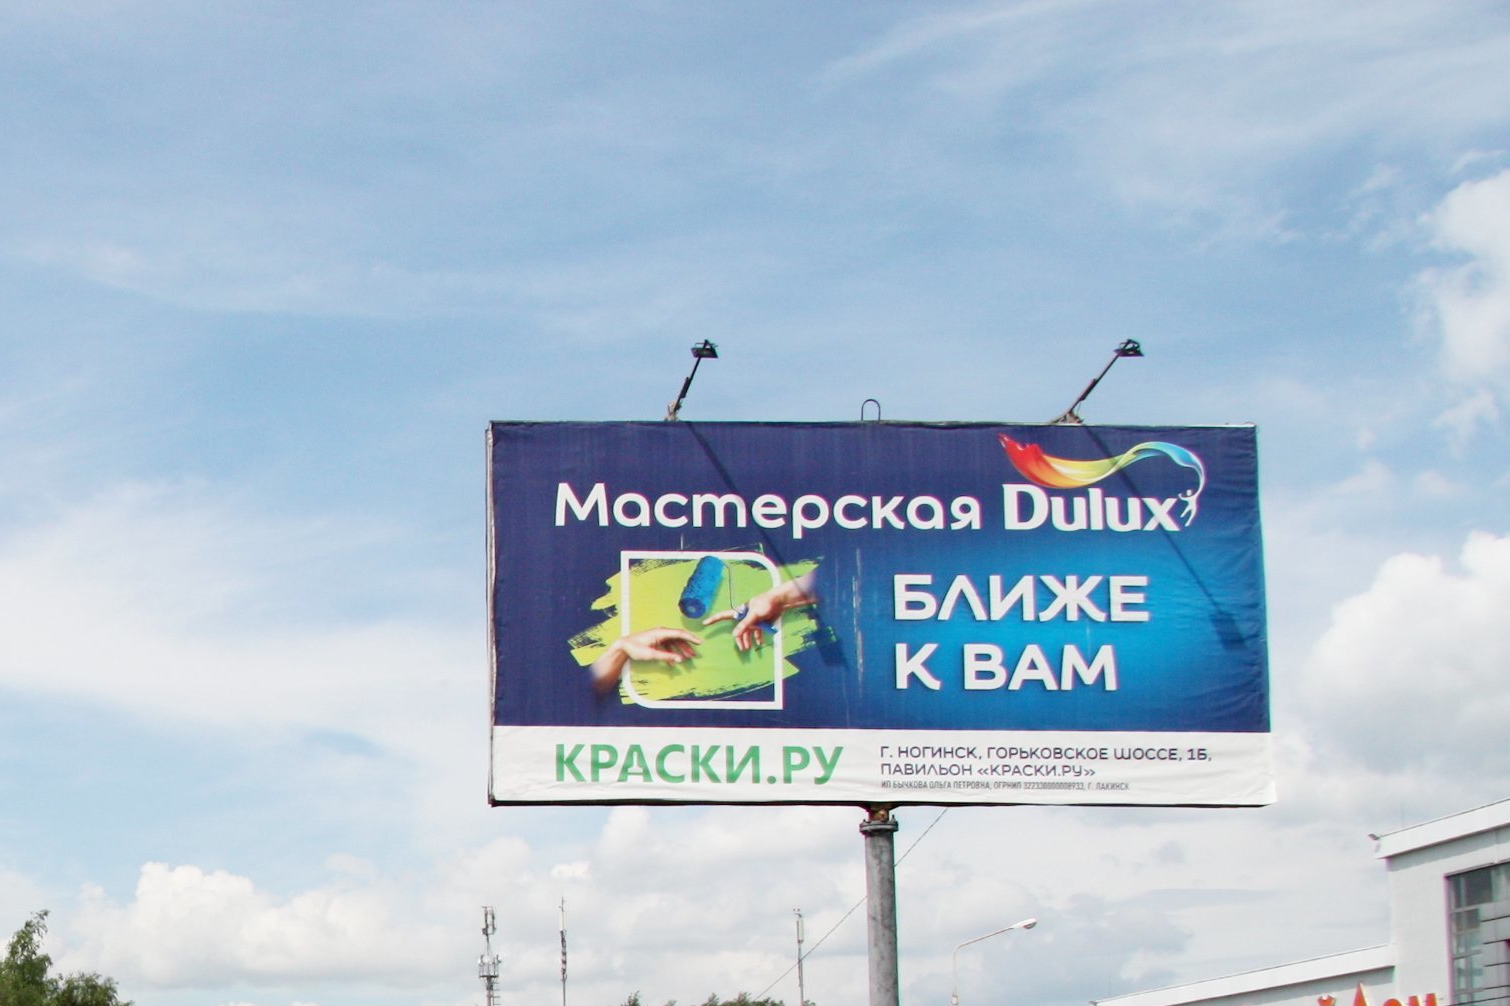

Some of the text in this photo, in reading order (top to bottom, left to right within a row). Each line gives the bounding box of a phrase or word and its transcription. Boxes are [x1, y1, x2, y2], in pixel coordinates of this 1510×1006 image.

[555, 482, 1180, 539] Мастерская Dulux
[893, 574, 1149, 623] БЛИЖЕ
[895, 644, 1118, 691] К ВАМ
[555, 743, 844, 785] КРАСКИ.РУ
[880, 746, 1213, 763] Г. НОГИНСК, ГОРЬКОВСКОЕ ШОССЕ, 1Б,
[881, 763, 1096, 777] ПАВИЛЬОН «КРАСКИ.РУ»
